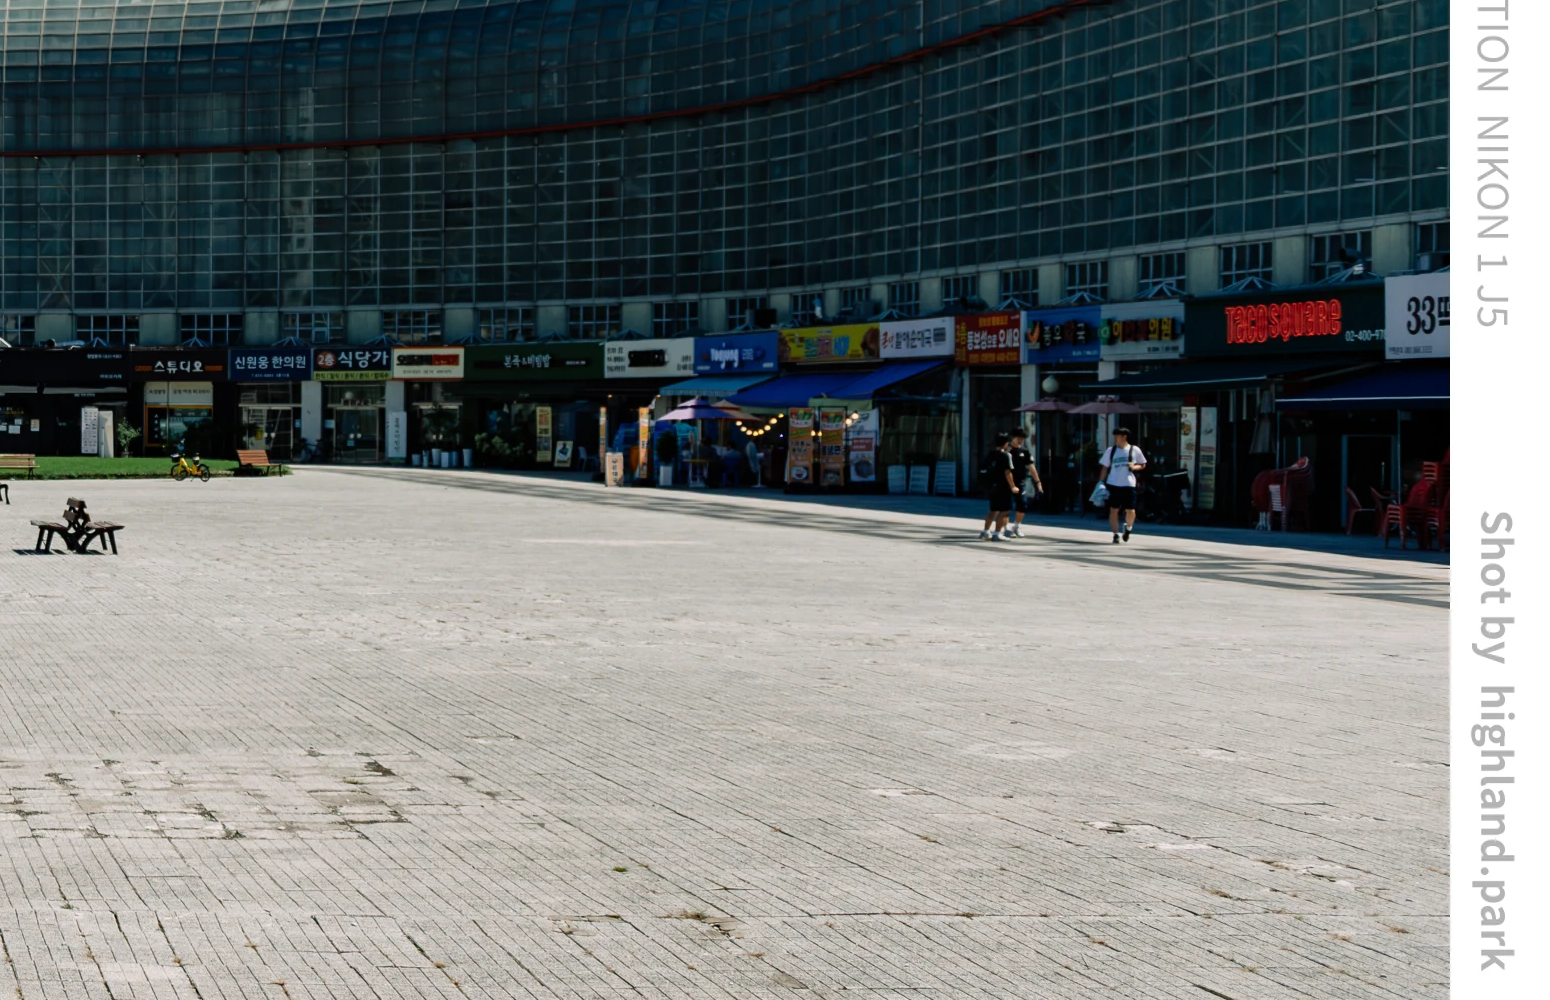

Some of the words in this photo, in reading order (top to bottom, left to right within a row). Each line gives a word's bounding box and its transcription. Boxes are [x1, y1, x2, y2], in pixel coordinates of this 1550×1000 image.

[998, 328, 1020, 348] 오세요
[153, 359, 205, 375] 스튜디오
[234, 355, 270, 370] 신원웅
[271, 355, 307, 369] 한의원
[317, 353, 335, 367] 2층
[337, 350, 390, 369] 식당가
